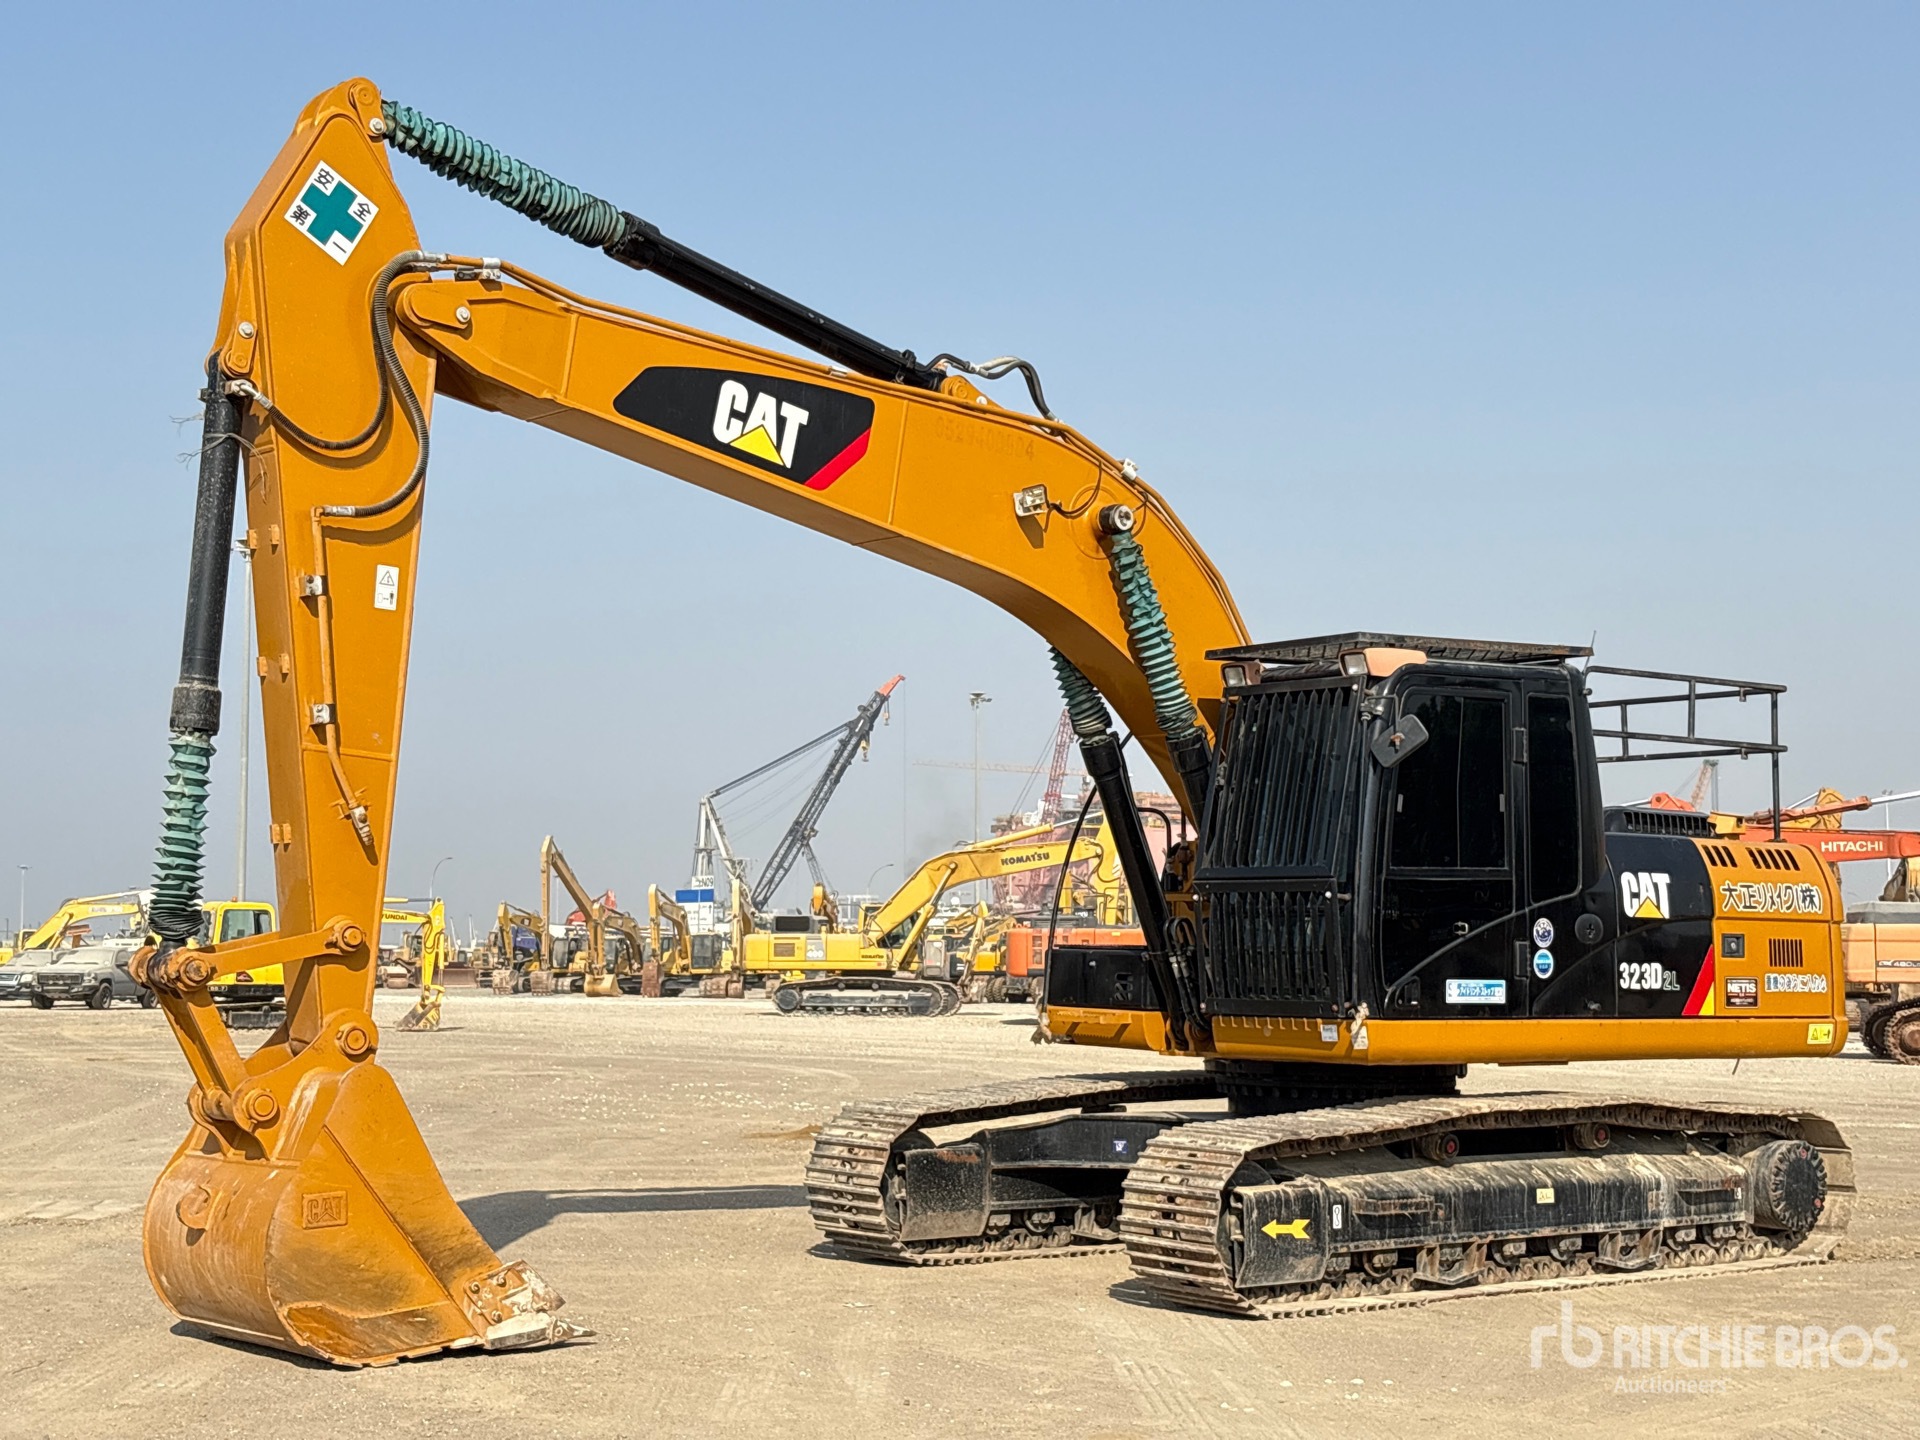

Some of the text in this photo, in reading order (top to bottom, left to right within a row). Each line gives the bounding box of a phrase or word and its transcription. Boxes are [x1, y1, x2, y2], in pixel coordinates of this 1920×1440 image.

[713, 380, 809, 469] CAT
[1821, 840, 1884, 852] HITACHI
[1001, 852, 1050, 866] KOMATSU
[1621, 872, 1671, 919] CAT
[381, 913, 408, 921] YUNDAI
[1620, 962, 1681, 991] 323D 2L
[1727, 982, 1757, 993] NETIS
[306, 1196, 344, 1225] CAT
